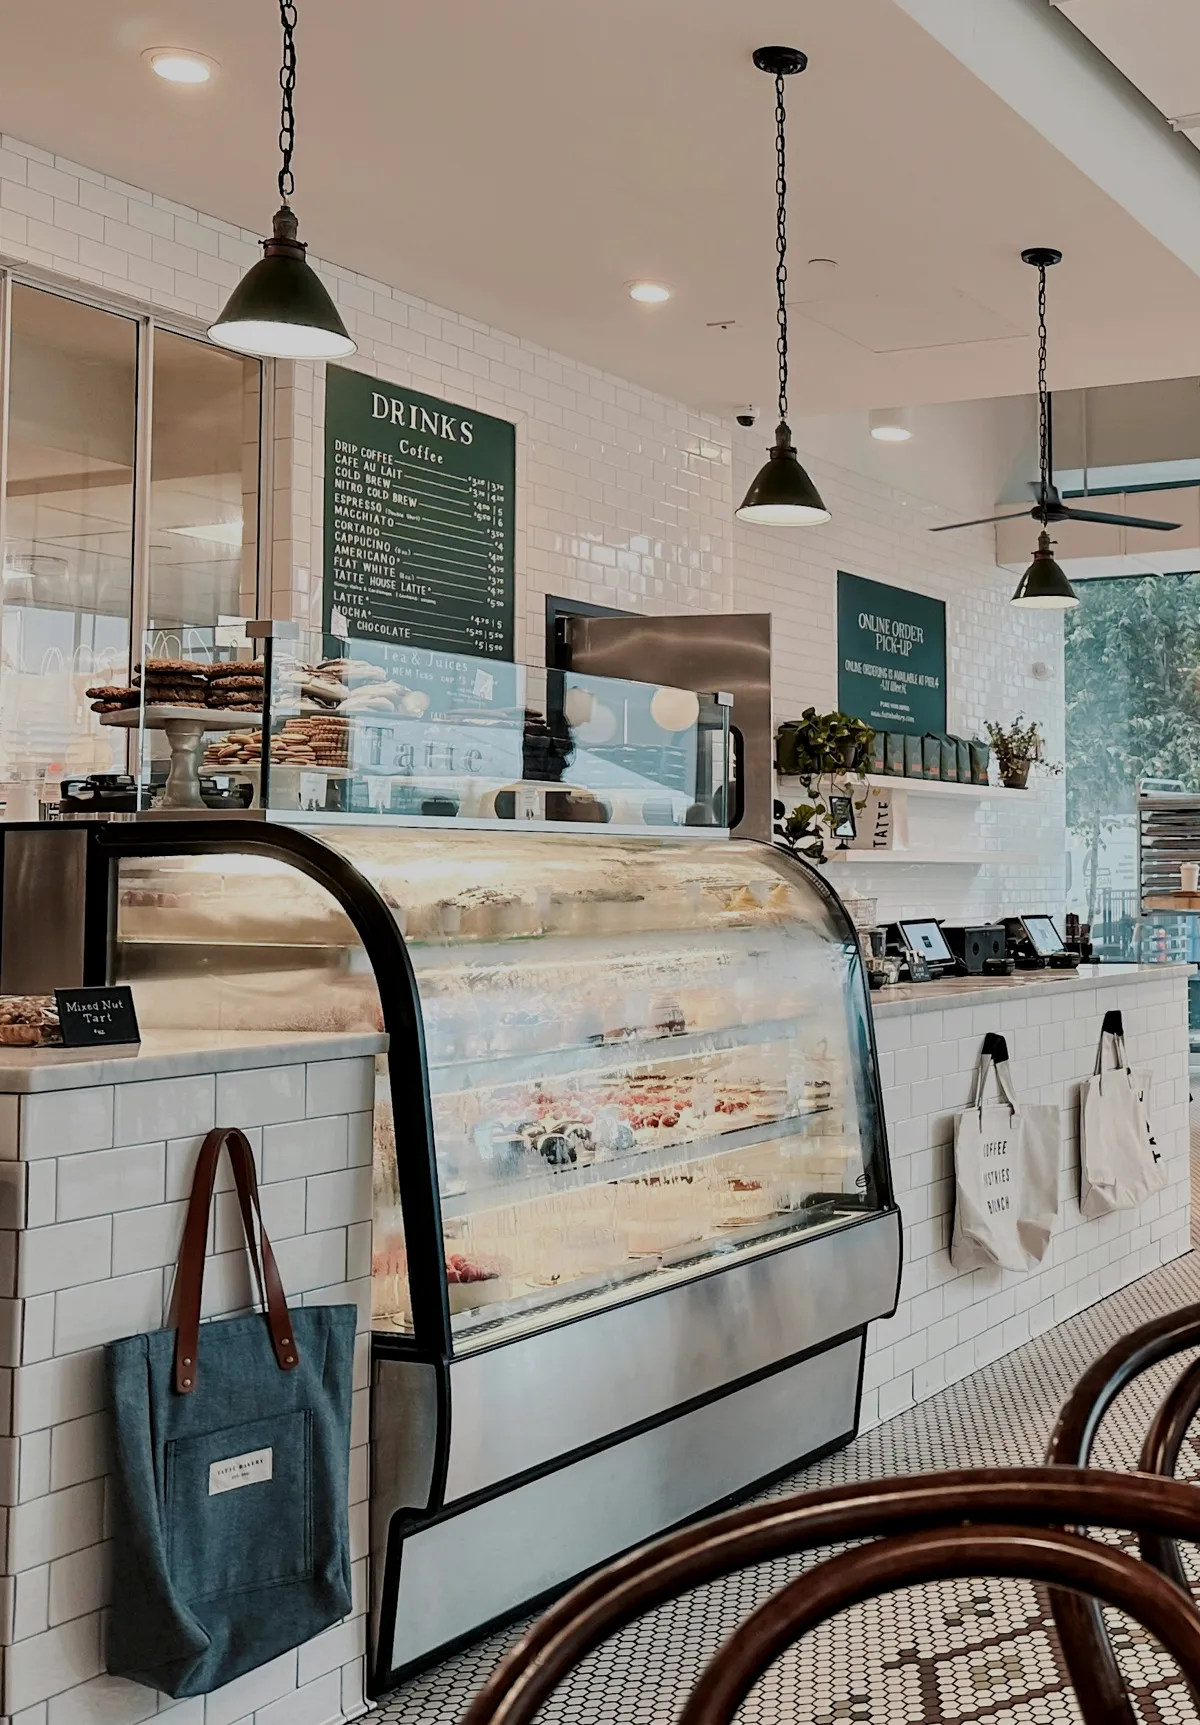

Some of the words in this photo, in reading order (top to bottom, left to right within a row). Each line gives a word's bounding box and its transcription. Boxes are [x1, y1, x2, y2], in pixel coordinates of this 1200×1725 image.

[372, 392, 473, 445] DRINKS
[335, 440, 358, 454] DRIP
[361, 448, 393, 465] COFFEE
[399, 439, 443, 464] Coffee
[335, 454, 359, 468] CAFE
[364, 461, 376, 472] AU
[381, 466, 402, 479] LAIT
[335, 466, 360, 480] COLD
[366, 474, 391, 488] BREW
[334, 479, 363, 493] NITRO
[367, 487, 389, 500] COLD
[393, 493, 417, 507] BREW
[334, 493, 382, 512] ESPRESSO
[334, 505, 394, 527] MACCHIATO
[335, 520, 380, 536] CORTADO
[334, 531, 390, 552] CAPPUCINO
[334, 556, 358, 569] FLAT
[363, 562, 396, 578] WHITE
[334, 569, 364, 584] TATTE
[370, 576, 396, 590] HOUSE
[357, 621, 410, 638] CHOCOLATE
[858, 613, 890, 635] ONLINE
[892, 621, 924, 644] ORDER
[876, 633, 912, 656] PICK-UP
[381, 646, 407, 662] Tea
[411, 652, 420, 665] &
[427, 652, 468, 672] Juices
[392, 667, 412, 677] MEM
[845, 659, 862, 674] ONLINE
[863, 664, 888, 678] ORDERING
[888, 669, 893, 679] IS
[894, 670, 918, 684] AVAILABLE
[919, 674, 924, 685] AT
[873, 802, 889, 847] TATTE
[66, 1002, 99, 1012] Mixed
[101, 1000, 124, 1010] Nut
[83, 1013, 112, 1023] Tart
